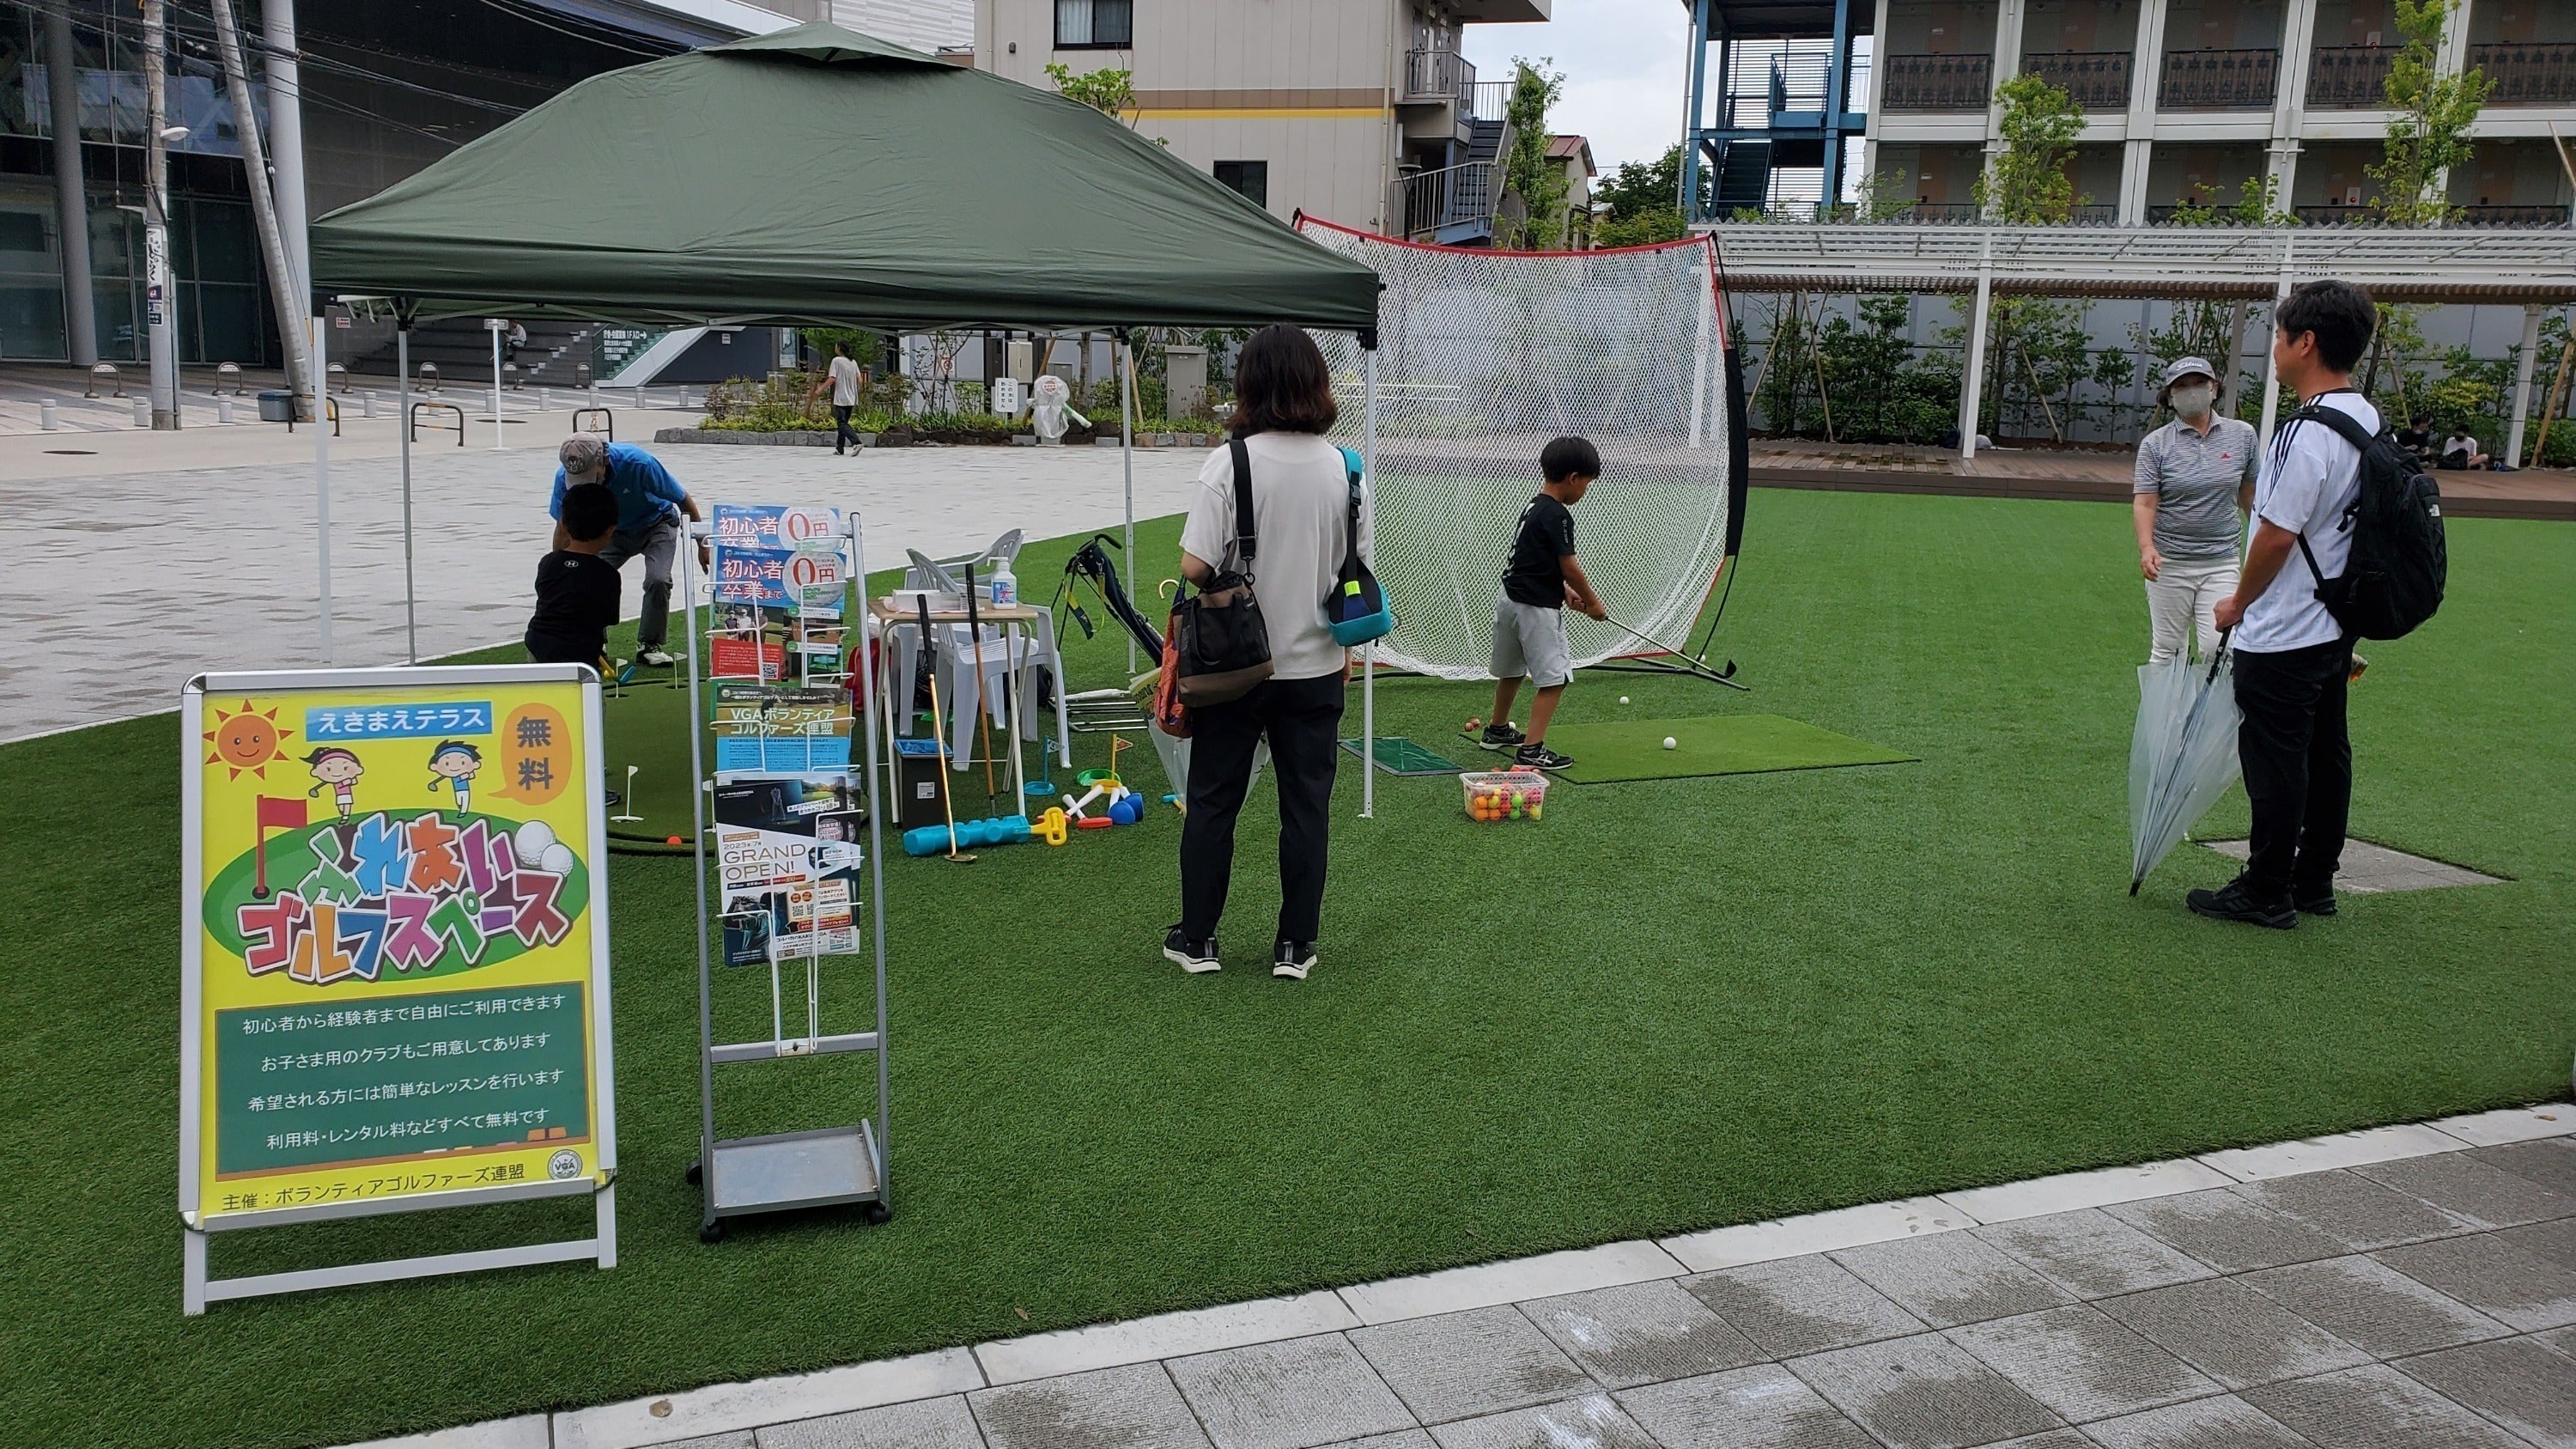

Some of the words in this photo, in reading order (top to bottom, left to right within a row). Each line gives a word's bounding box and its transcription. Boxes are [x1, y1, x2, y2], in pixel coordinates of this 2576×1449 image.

[720, 516, 778, 535] 初心者
[723, 559, 783, 579] 初心者
[793, 557, 835, 586] 0円
[722, 580, 783, 601] 卒業まで
[319, 707, 485, 734] えきまえテラス
[516, 715, 554, 791] 無料
[301, 812, 515, 908] ふれあい
[724, 843, 805, 864] GRAND
[726, 861, 794, 880] OPEN!
[238, 869, 570, 982] ゴルフスペース
[243, 994, 566, 1035] 初心者から経験者まで自由にご利用できます
[261, 1032, 551, 1072] お子さま用のクラブもご用意してあります
[248, 1069, 564, 1113] 希望される方には簡単なレッスンを行います
[266, 1108, 550, 1150] 利用料・レンタル料などすべて無料です
[555, 1160, 575, 1171] VGA
